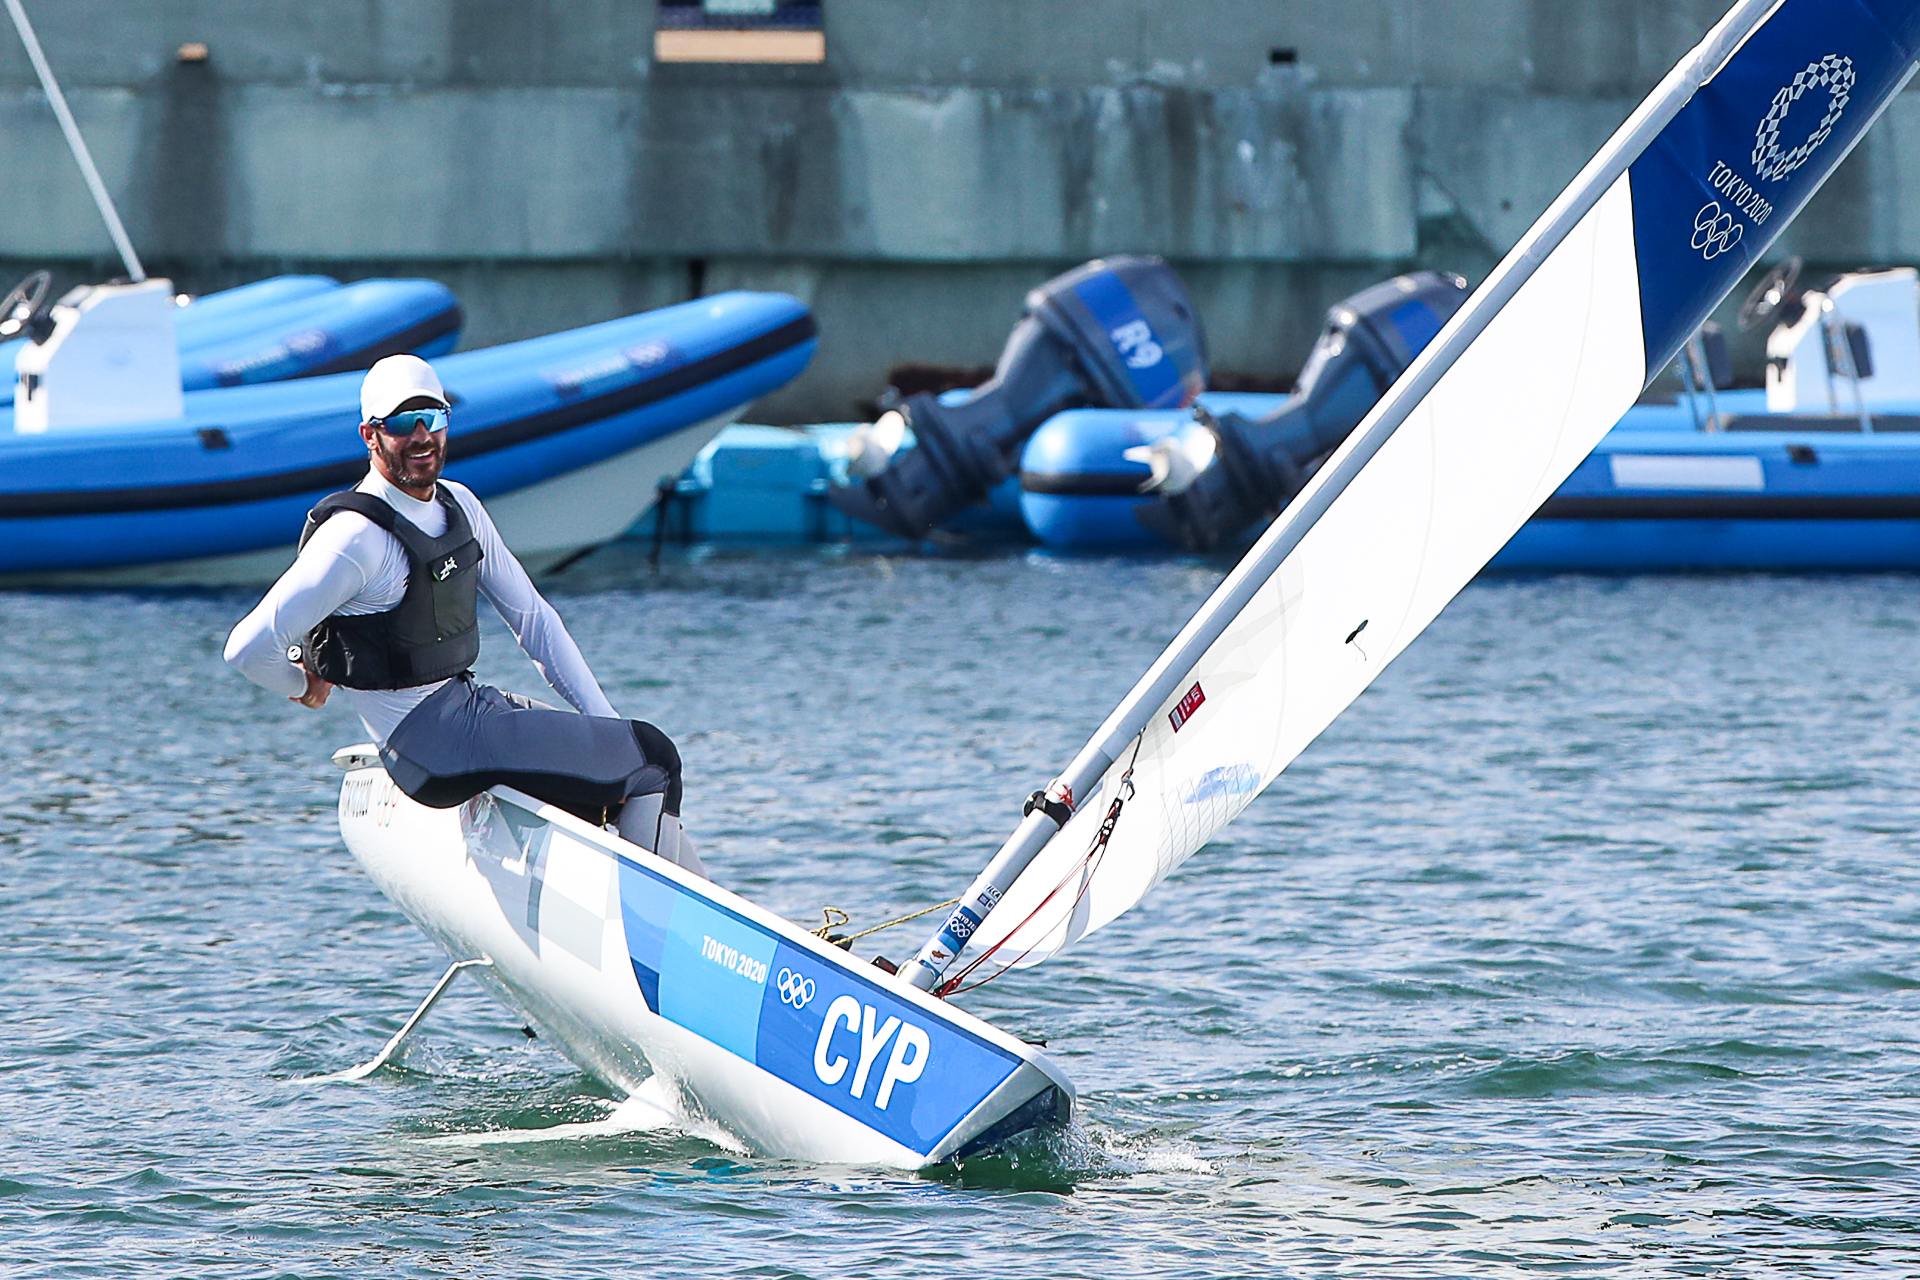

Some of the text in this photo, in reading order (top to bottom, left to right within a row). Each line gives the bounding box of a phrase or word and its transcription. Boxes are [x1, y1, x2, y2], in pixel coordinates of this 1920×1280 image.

[1707, 160, 1774, 226] TOKYO 2020
[1110, 319, 1163, 369] R9
[702, 935, 767, 984] TOKYO 2020
[813, 995, 931, 1111] CYP
